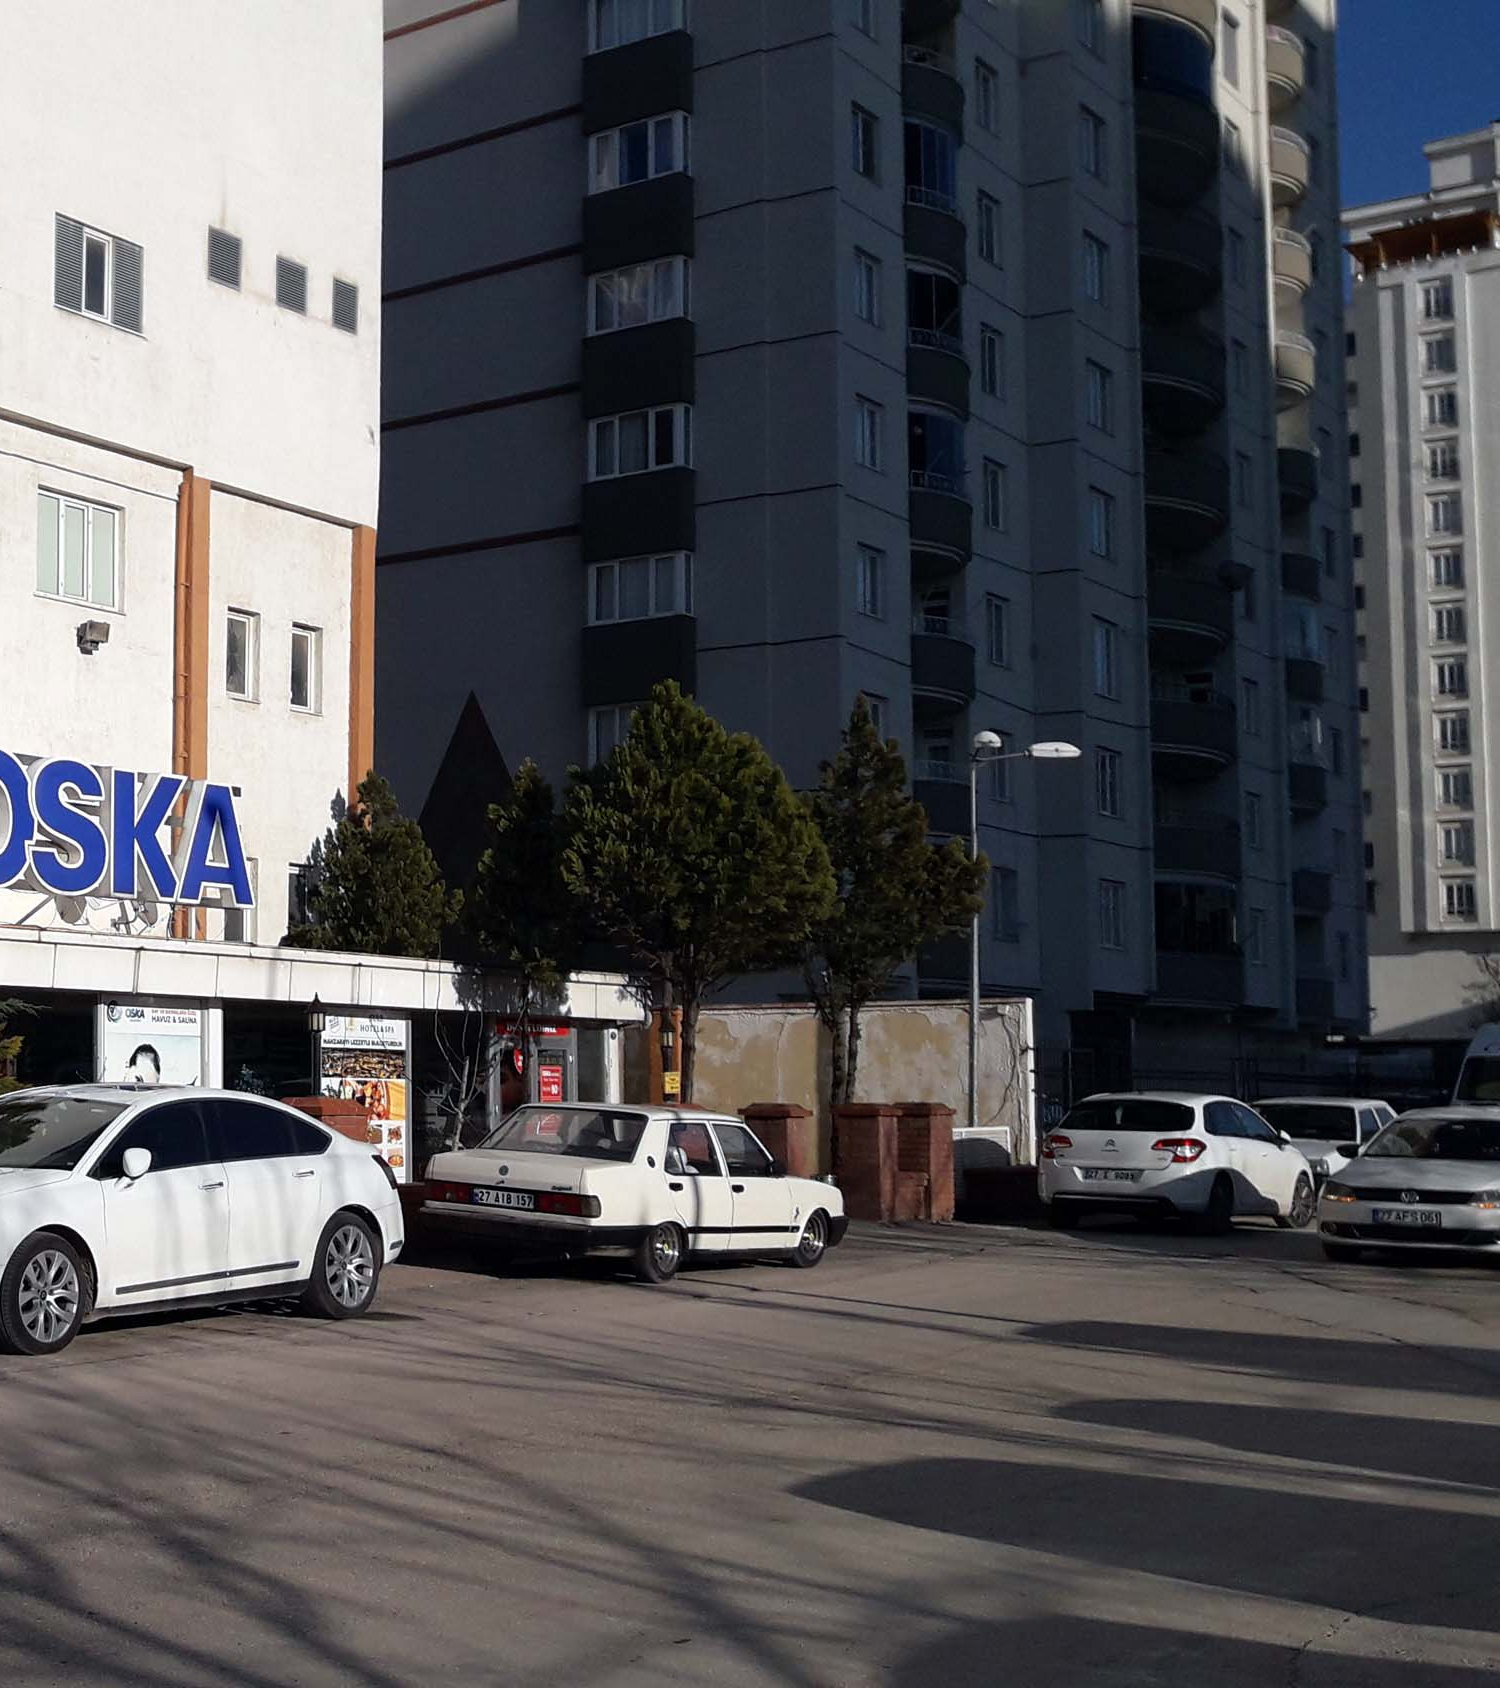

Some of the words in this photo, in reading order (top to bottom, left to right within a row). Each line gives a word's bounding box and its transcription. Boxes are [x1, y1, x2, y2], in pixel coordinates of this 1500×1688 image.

[479, 1190, 491, 1202] 27
[494, 1192, 512, 1204] AIB
[516, 1194, 533, 1208] 157
